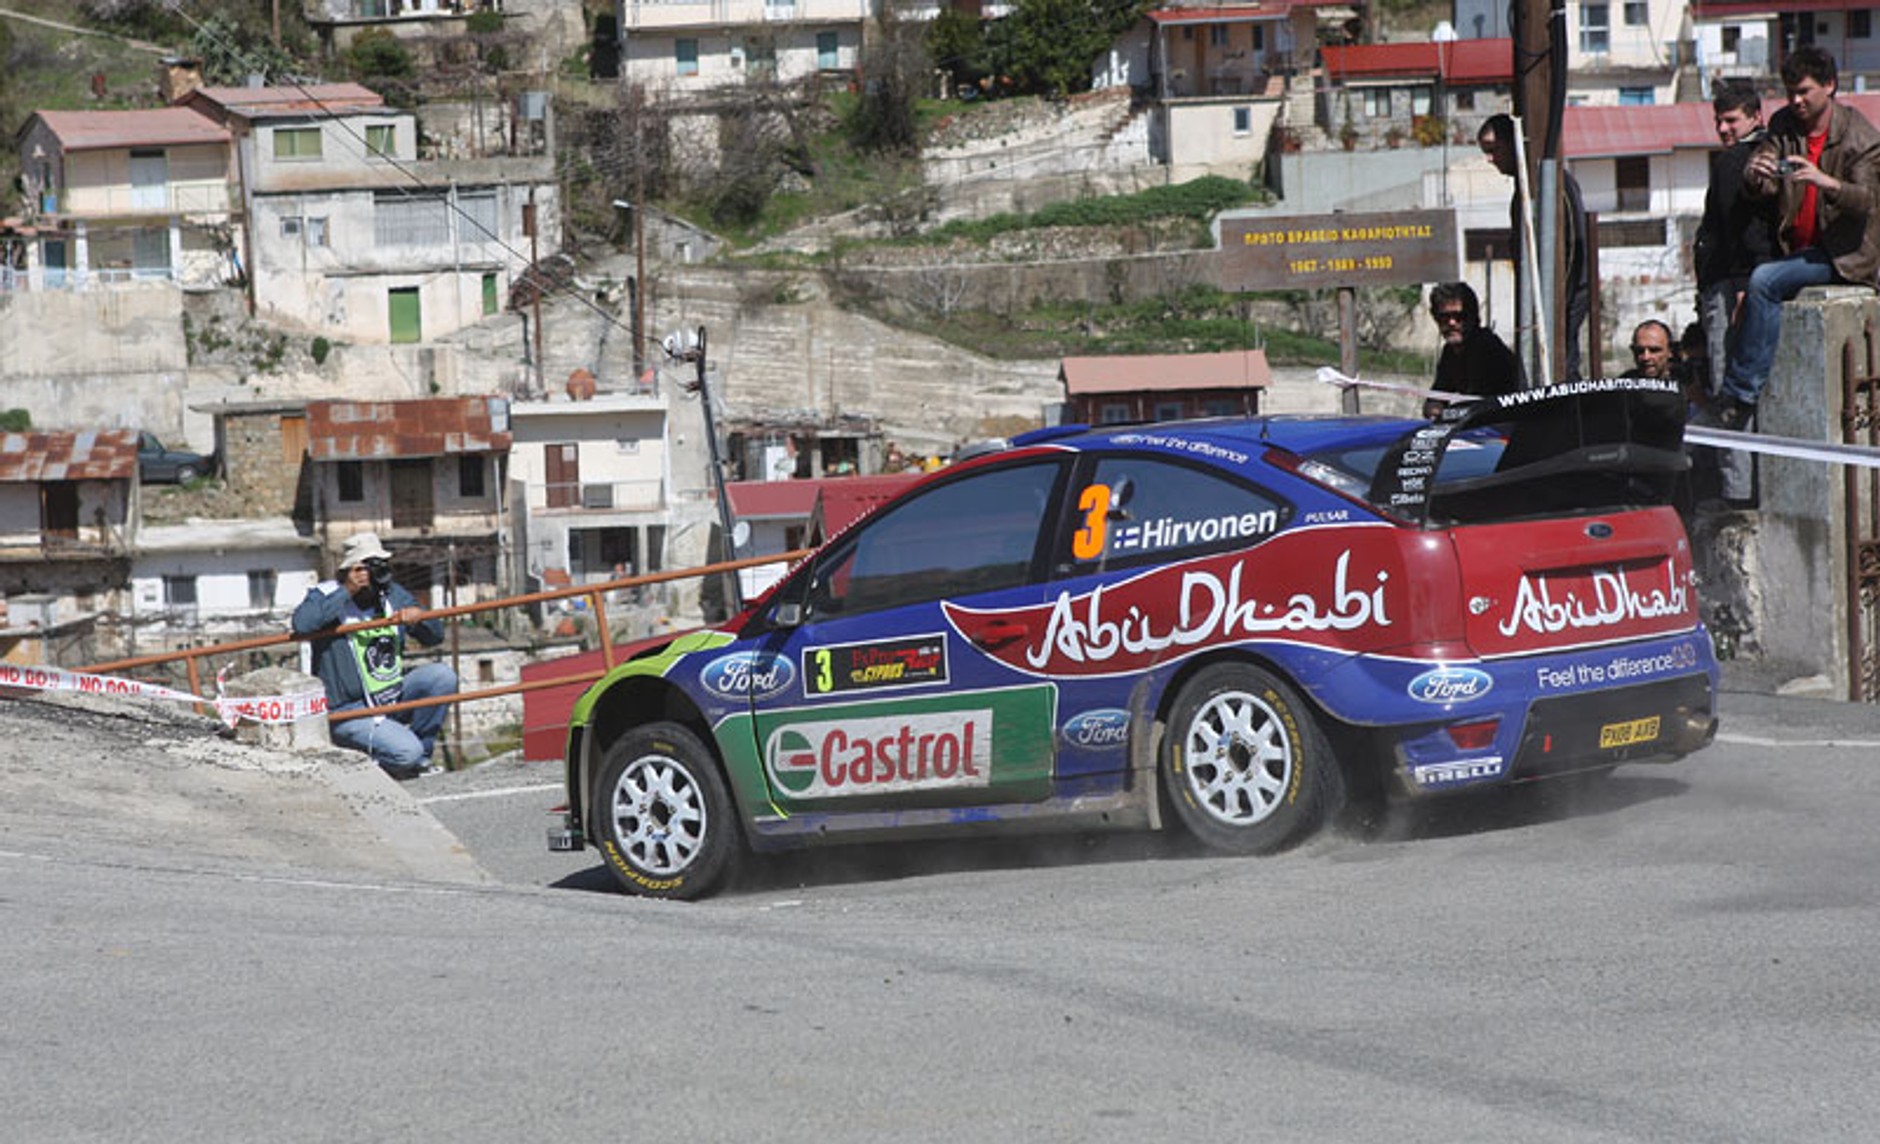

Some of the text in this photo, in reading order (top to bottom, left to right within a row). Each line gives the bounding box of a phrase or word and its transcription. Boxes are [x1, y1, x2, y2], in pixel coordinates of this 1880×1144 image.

[1072, 484, 1111, 559] 3
[1142, 509, 1277, 549] Hirvonen
[718, 660, 780, 693] Ford
[815, 648, 834, 692] 3
[1423, 678, 1478, 699] Ford
[1537, 664, 1576, 689] Feel
[1577, 664, 1605, 684] the
[1607, 653, 1674, 680] difference
[1078, 716, 1128, 743] Ford
[820, 719, 980, 788] Castrol
